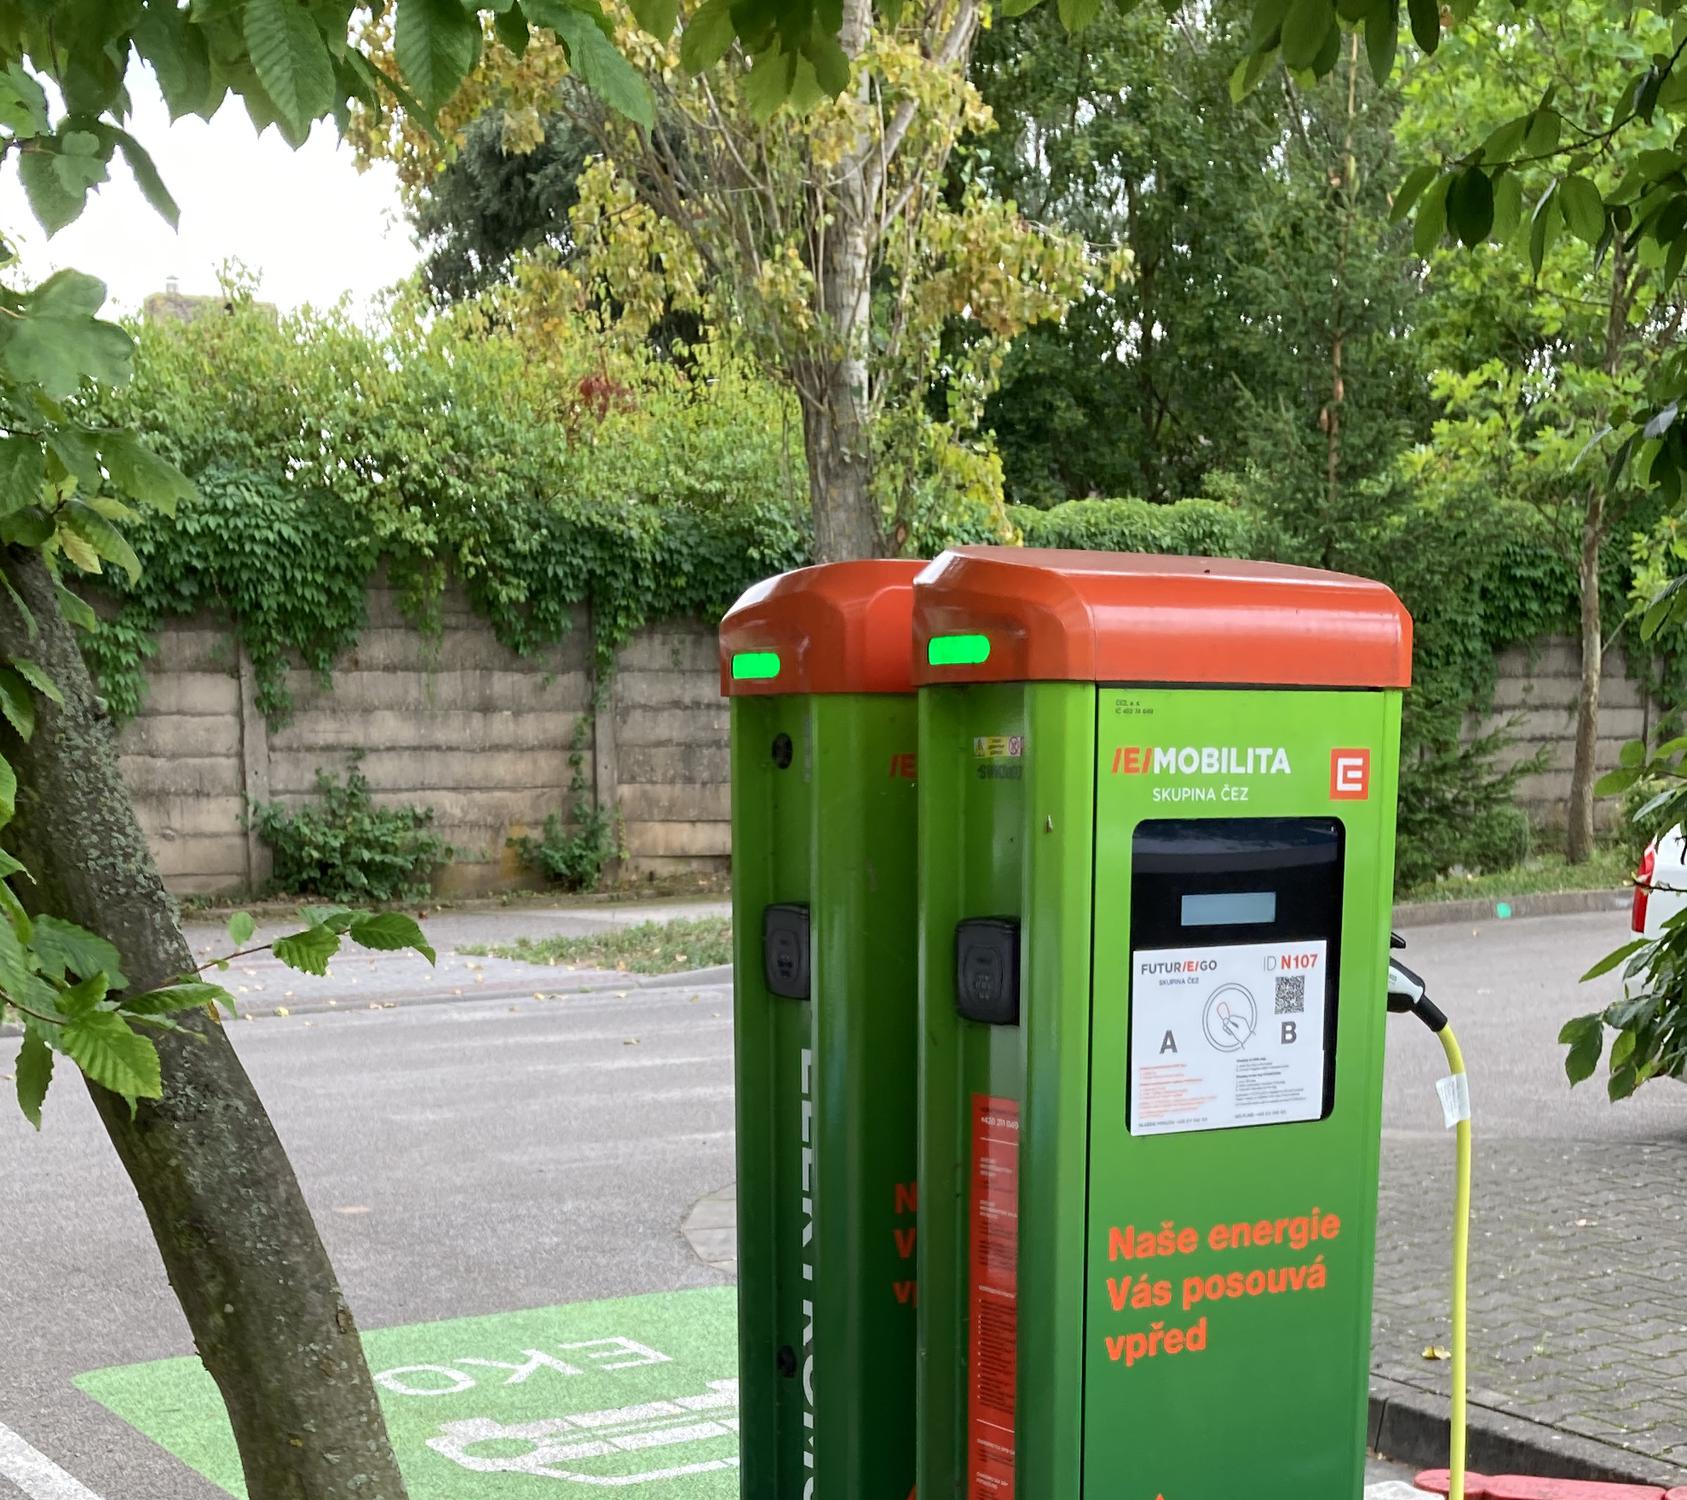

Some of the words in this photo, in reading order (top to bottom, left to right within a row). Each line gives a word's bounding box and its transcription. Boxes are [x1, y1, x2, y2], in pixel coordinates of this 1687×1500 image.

[1152, 787, 1216, 801] SKUPINA
[1221, 784, 1249, 801] ČEZ
[1263, 955, 1277, 972] ID
[1281, 953, 1318, 970] N107
[1158, 978, 1186, 987] SKUPINA
[1159, 1029, 1178, 1055] A
[1280, 1020, 1298, 1045] B
[1108, 1220, 1199, 1262] Naše
[1208, 1205, 1341, 1250] energie
[1106, 1273, 1172, 1312] Vás
[1182, 1253, 1326, 1311] posouvá
[1105, 1316, 1208, 1368] vpřed
[374, 1336, 674, 1397] EKO
